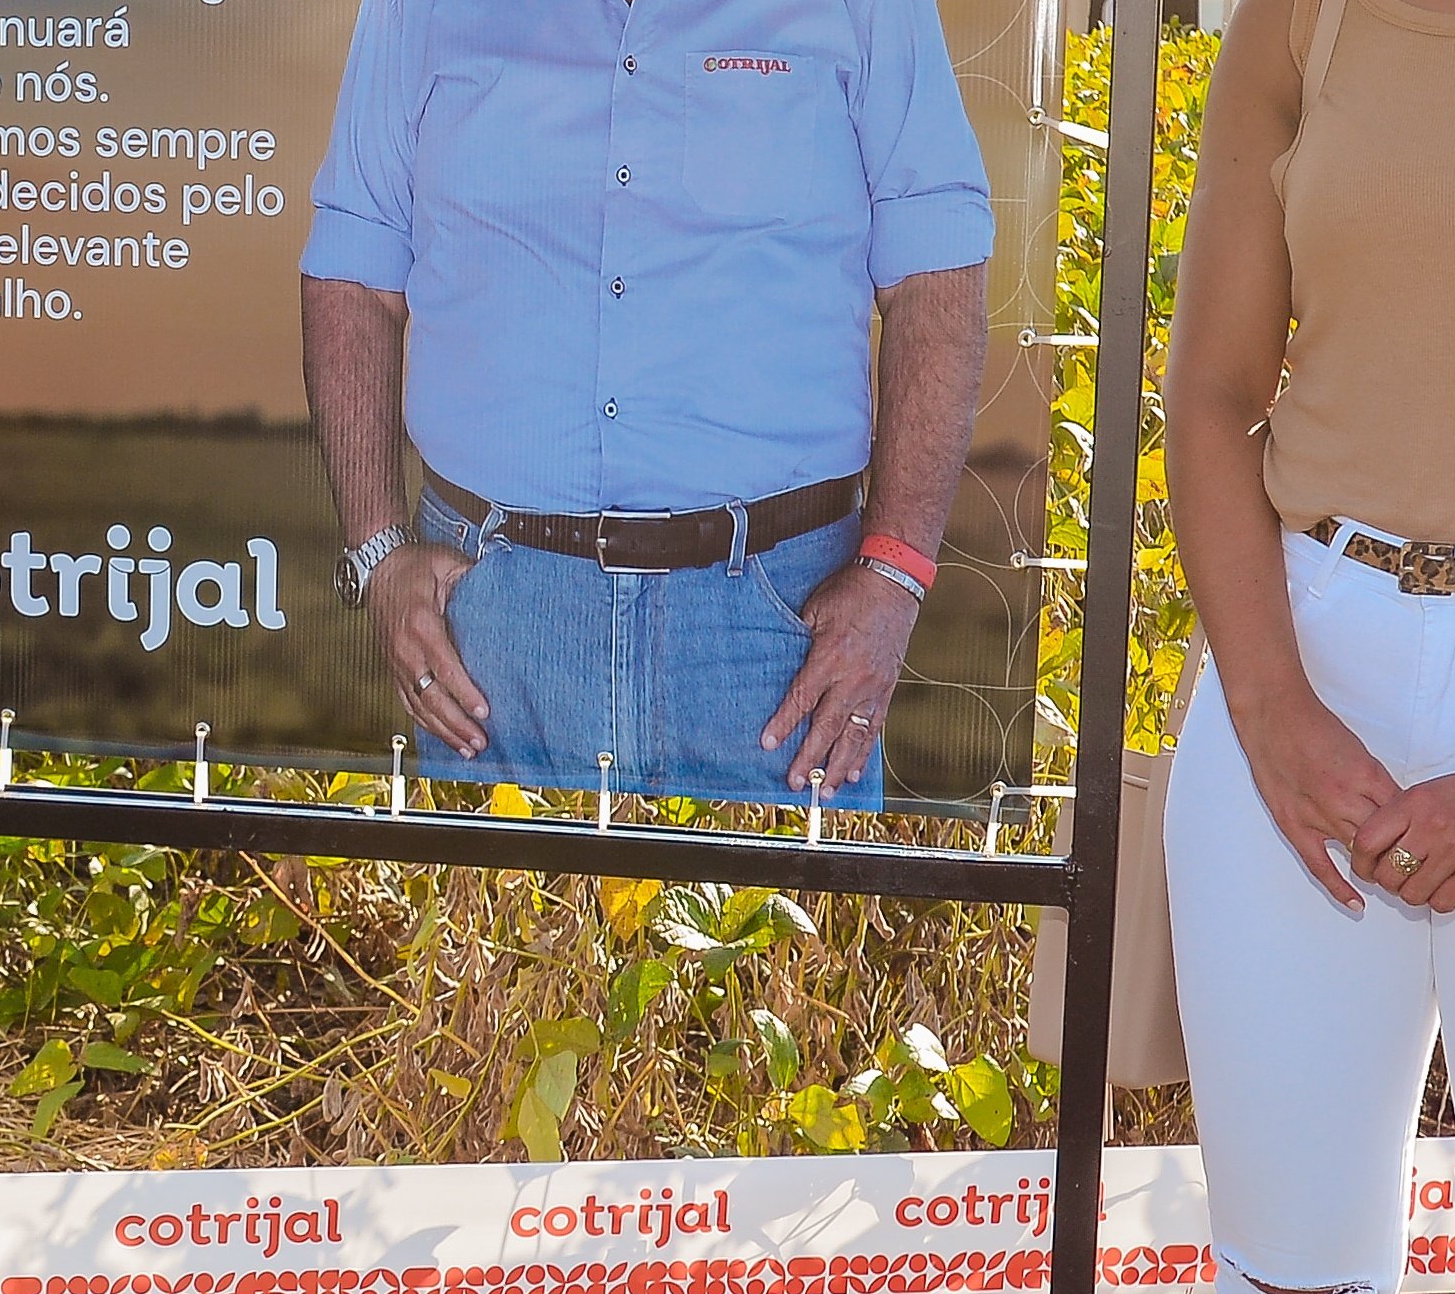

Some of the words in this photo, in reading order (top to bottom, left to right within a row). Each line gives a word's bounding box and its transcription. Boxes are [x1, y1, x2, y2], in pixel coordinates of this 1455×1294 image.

[15, 60, 111, 104] nós.
[703, 56, 792, 76] COTRIJAL
[94, 125, 277, 171] sempre
[181, 174, 286, 226] pelo
[113, 1196, 343, 1258] cotrijal
[509, 1187, 732, 1251] cotrijal
[894, 1177, 1107, 1238] cotrij
